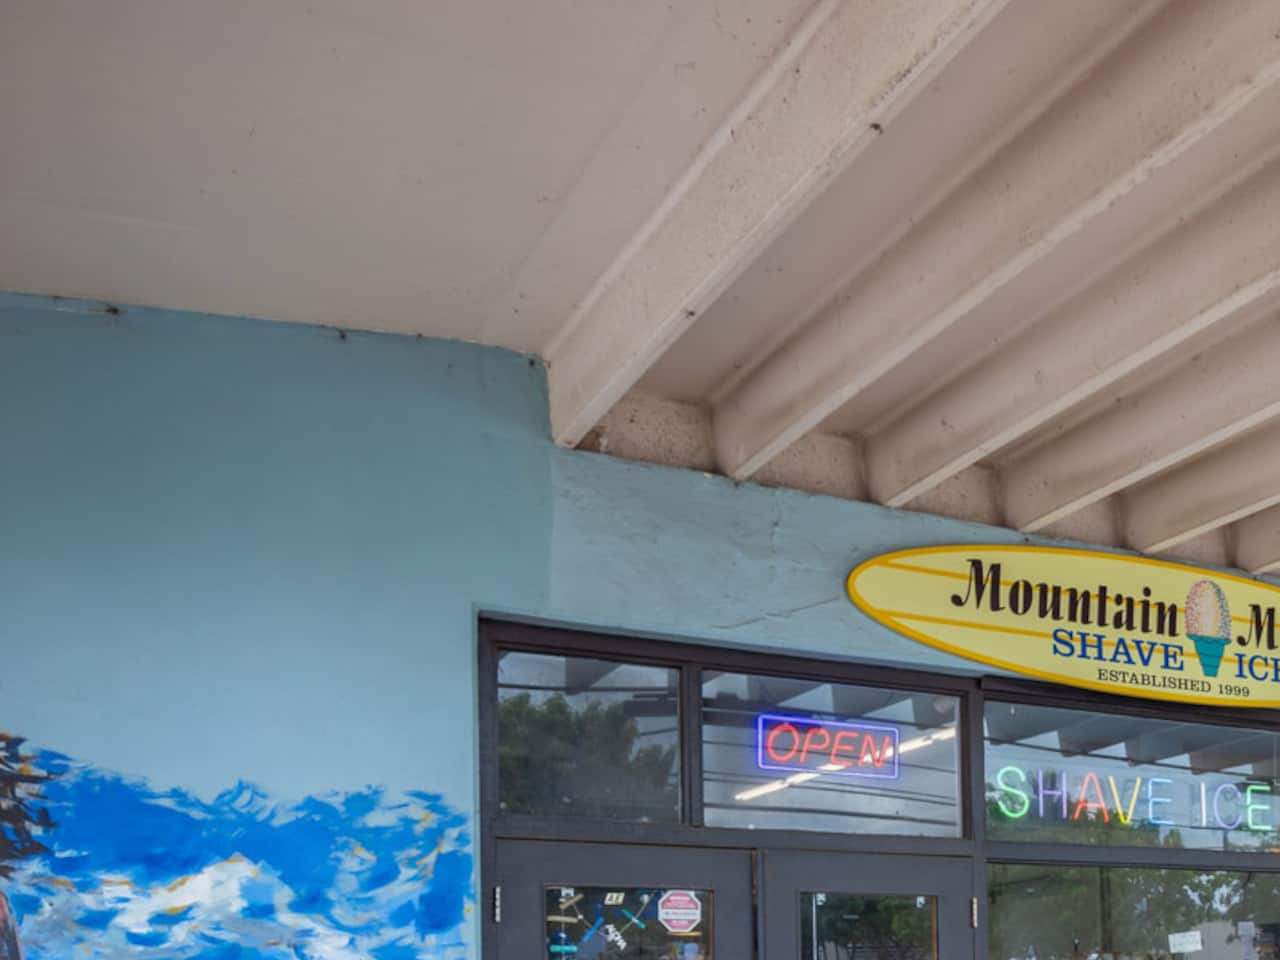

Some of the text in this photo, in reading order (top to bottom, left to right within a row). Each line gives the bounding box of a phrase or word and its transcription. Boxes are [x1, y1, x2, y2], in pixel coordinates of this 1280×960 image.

[951, 559, 1181, 638] Mountain
[1052, 629, 1185, 672] SHAVE
[1097, 669, 1251, 698] ESTABLISHED 1999
[766, 723, 892, 768] OPEN
[997, 766, 1273, 831] SHAVE ICE
